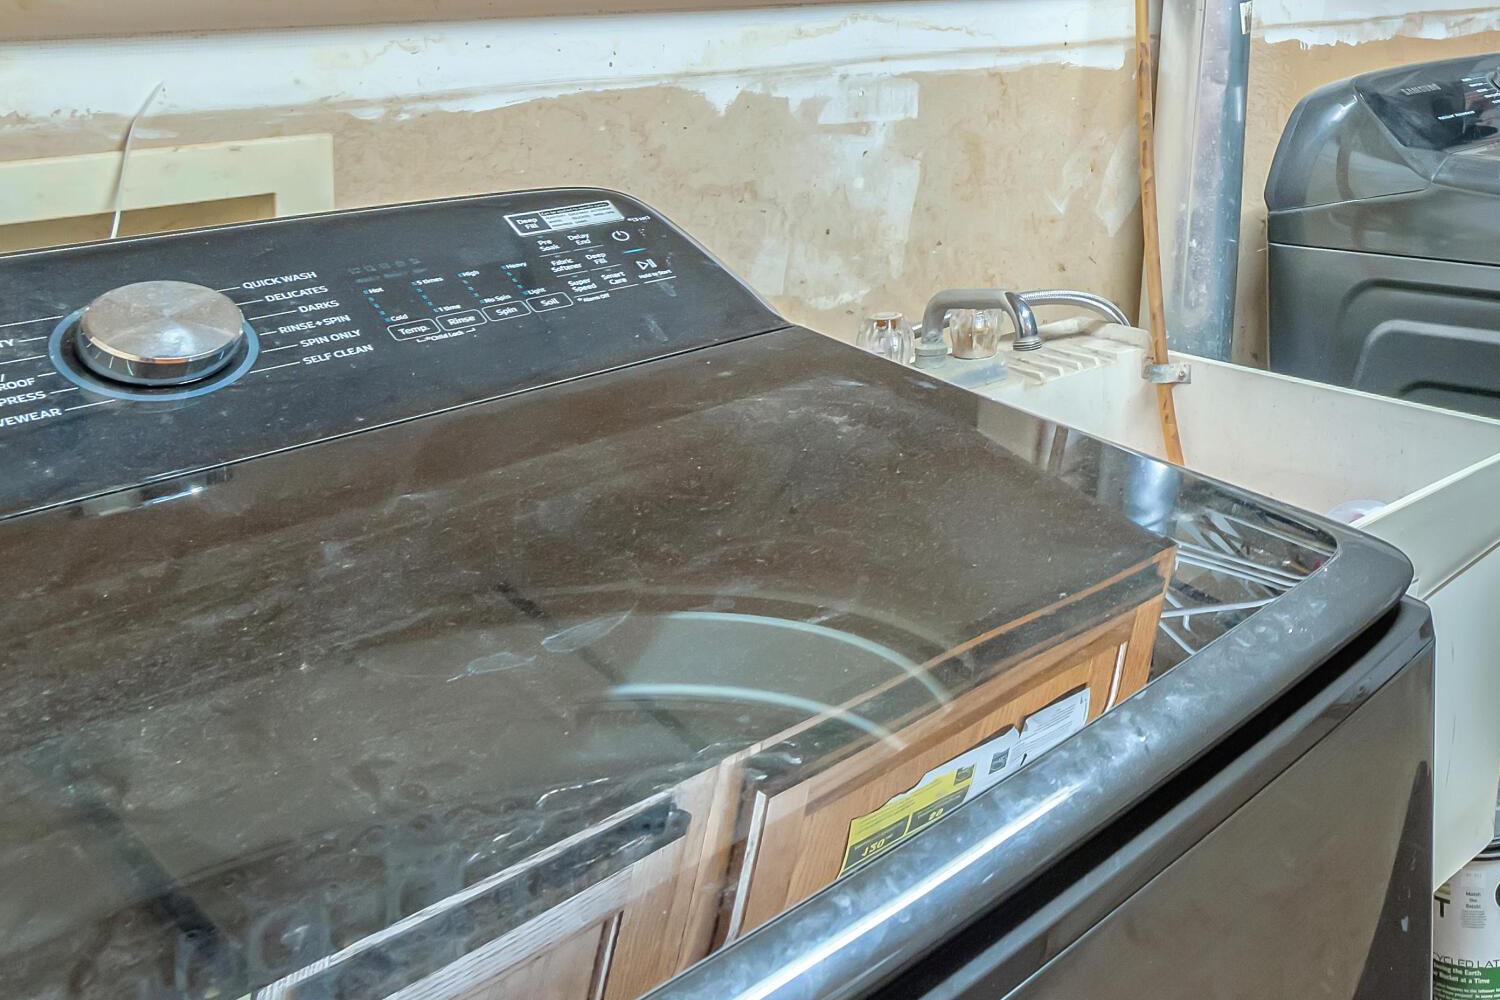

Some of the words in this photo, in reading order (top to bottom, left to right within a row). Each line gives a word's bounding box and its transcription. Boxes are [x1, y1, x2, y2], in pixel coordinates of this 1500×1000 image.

[516, 217, 538, 226] Deep
[567, 232, 590, 242] Delay
[575, 238, 591, 246] End
[537, 239, 553, 247] Pre
[539, 243, 561, 252] Soak
[585, 252, 607, 261] Deep
[550, 258, 575, 267] Fabric
[551, 262, 582, 273] Softener
[242, 276, 282, 290] QUICK
[281, 271, 318, 284] WASH
[601, 271, 626, 281] Smart
[609, 277, 628, 285] Care
[567, 277, 591, 288] Super
[368, 286, 385, 294] Hot
[571, 283, 598, 293] Speed
[264, 285, 329, 303] DELICATES
[297, 299, 340, 313] DARKS
[540, 297, 560, 307] Soil
[495, 306, 519, 317] Spin
[390, 313, 409, 322] Cold
[448, 315, 476, 326] Rinse
[397, 325, 431, 336] Temp.
[300, 336, 330, 348] SPIN
[330, 329, 361, 342] ONLY
[302, 352, 333, 366] SELF
[333, 344, 374, 359] CLEAN
